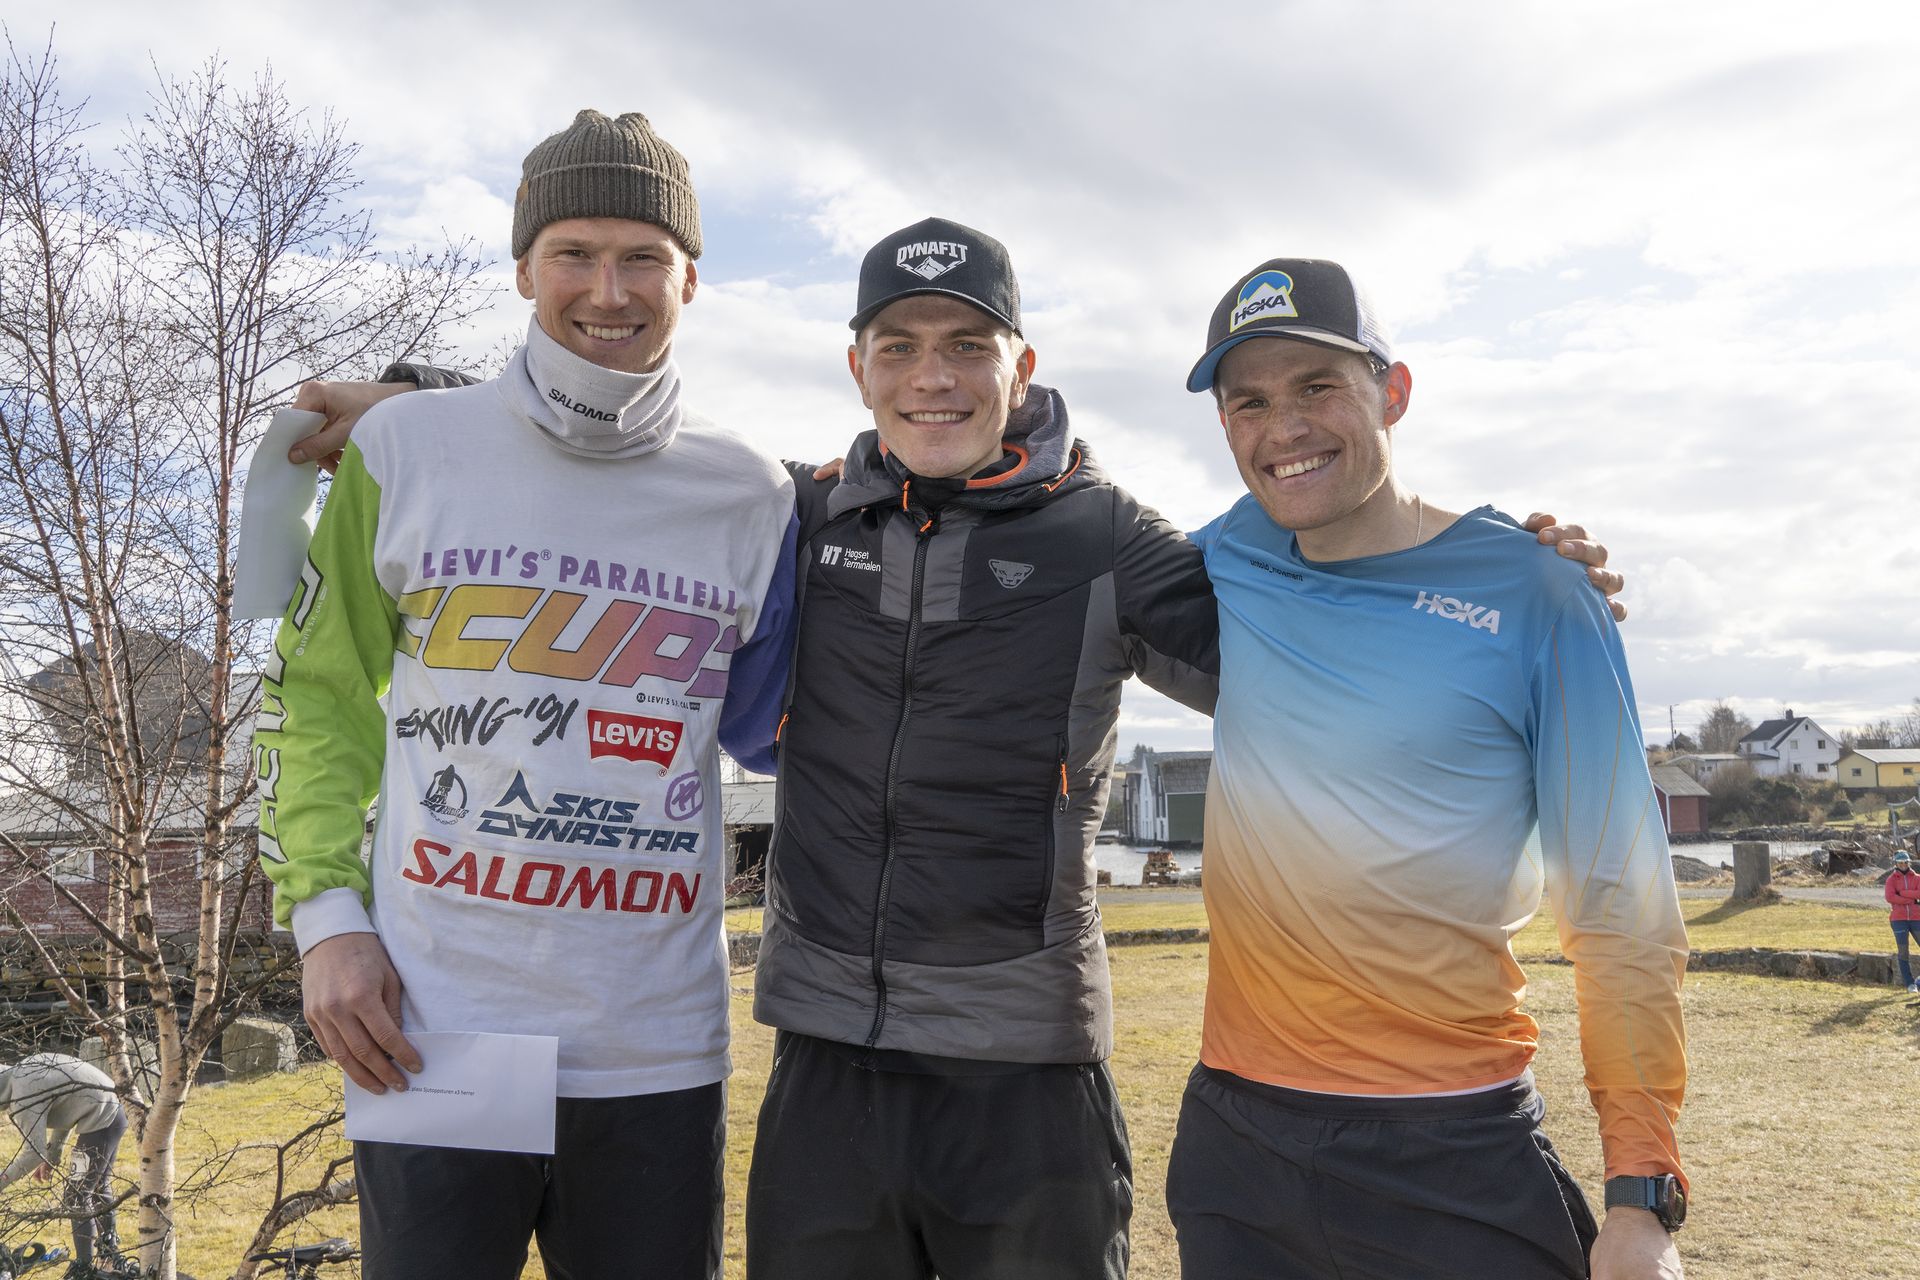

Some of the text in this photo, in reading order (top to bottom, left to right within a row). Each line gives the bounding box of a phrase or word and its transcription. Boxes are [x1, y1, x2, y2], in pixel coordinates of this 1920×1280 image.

[897, 241, 968, 264] DYNAFIT
[1233, 294, 1287, 325] HOKA
[549, 388, 623, 423] SALOMO
[820, 544, 843, 566] HT
[842, 557, 881, 572] Terminalen
[558, 555, 738, 616] PARALLELL
[1411, 590, 1501, 635] HOKA
[395, 696, 522, 752] SKIING
[544, 792, 640, 824] SKIS
[475, 809, 700, 853] DYNASTAR
[402, 838, 701, 914] SALOMON
